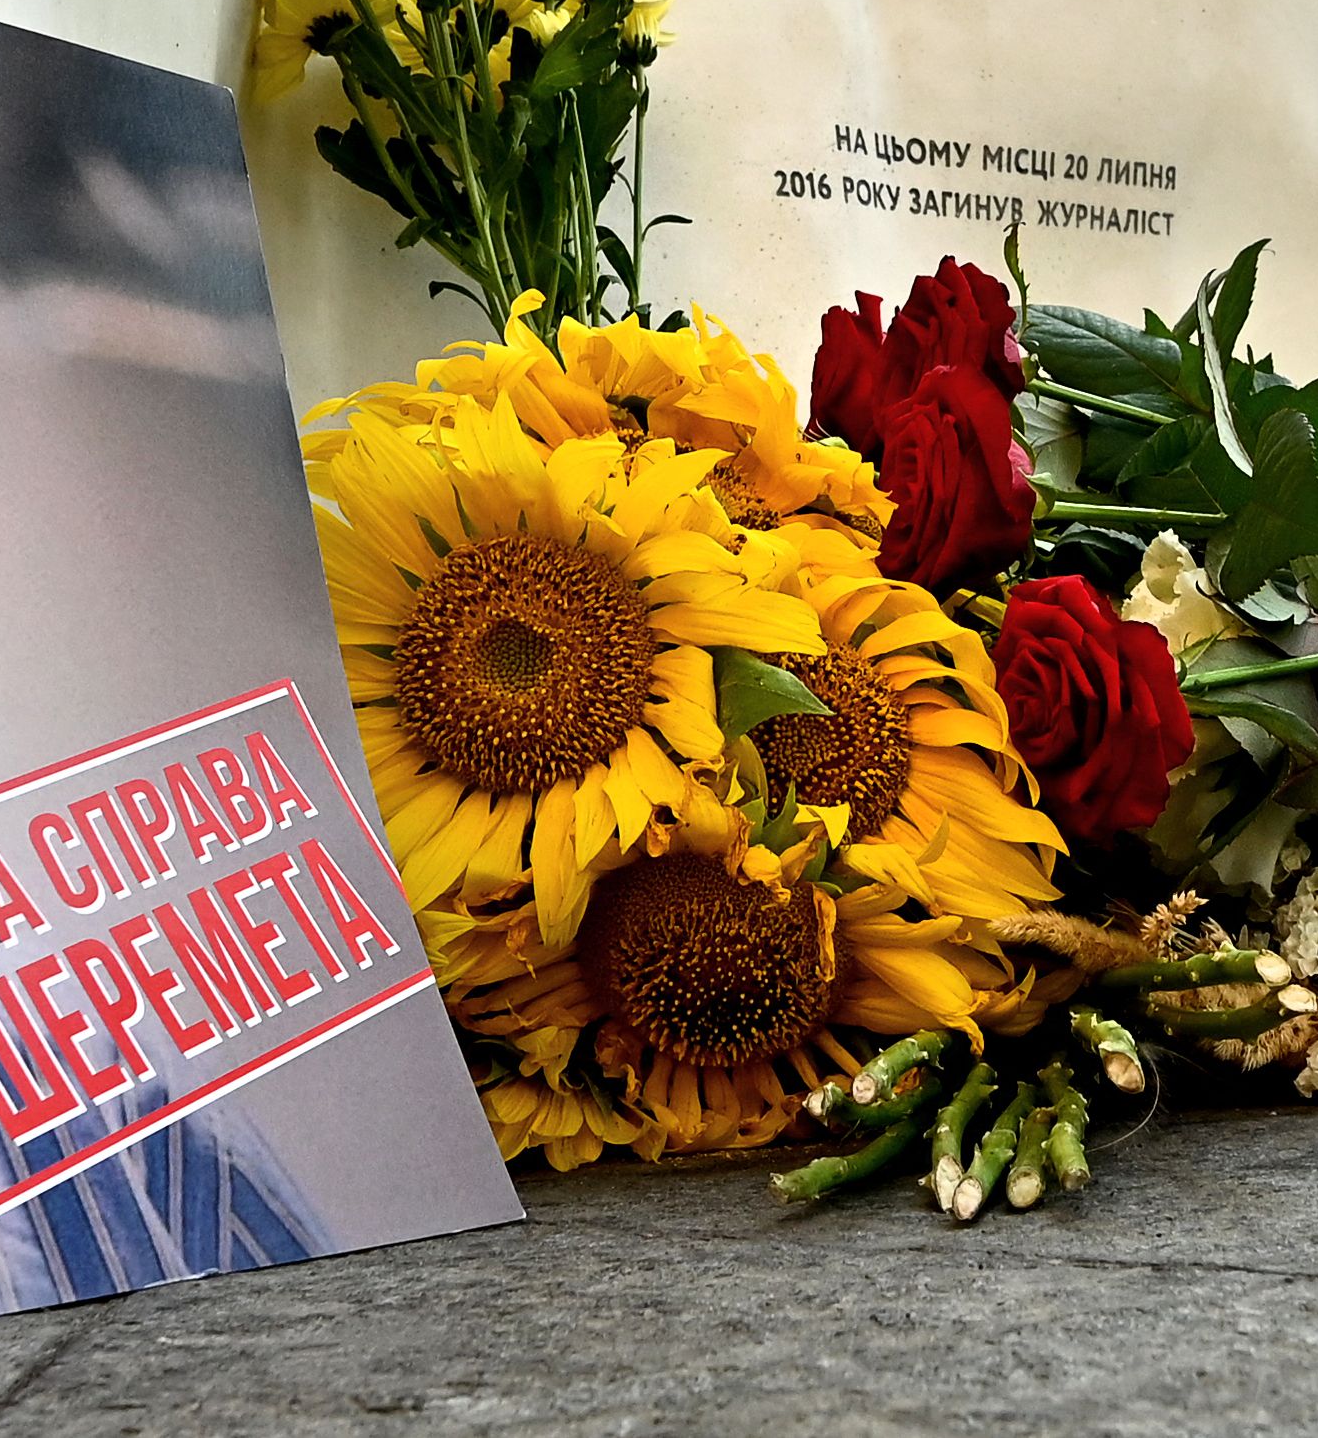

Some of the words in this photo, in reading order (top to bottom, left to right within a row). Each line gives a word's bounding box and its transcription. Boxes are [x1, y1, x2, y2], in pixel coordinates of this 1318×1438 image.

[834, 124, 868, 156] НА
[875, 131, 971, 167] ЦЬОМУ
[981, 144, 1056, 178] МІСЦІ
[1063, 153, 1088, 181] 20
[1096, 157, 1177, 191] ЛИПНЯ
[774, 170, 832, 200] 2016
[843, 176, 901, 212] РОКУ
[908, 187, 1023, 223] ЗАГИНУВ
[1037, 199, 1174, 237] ЖУРНАЛІСТ
[26, 730, 319, 917] СПРАВА
